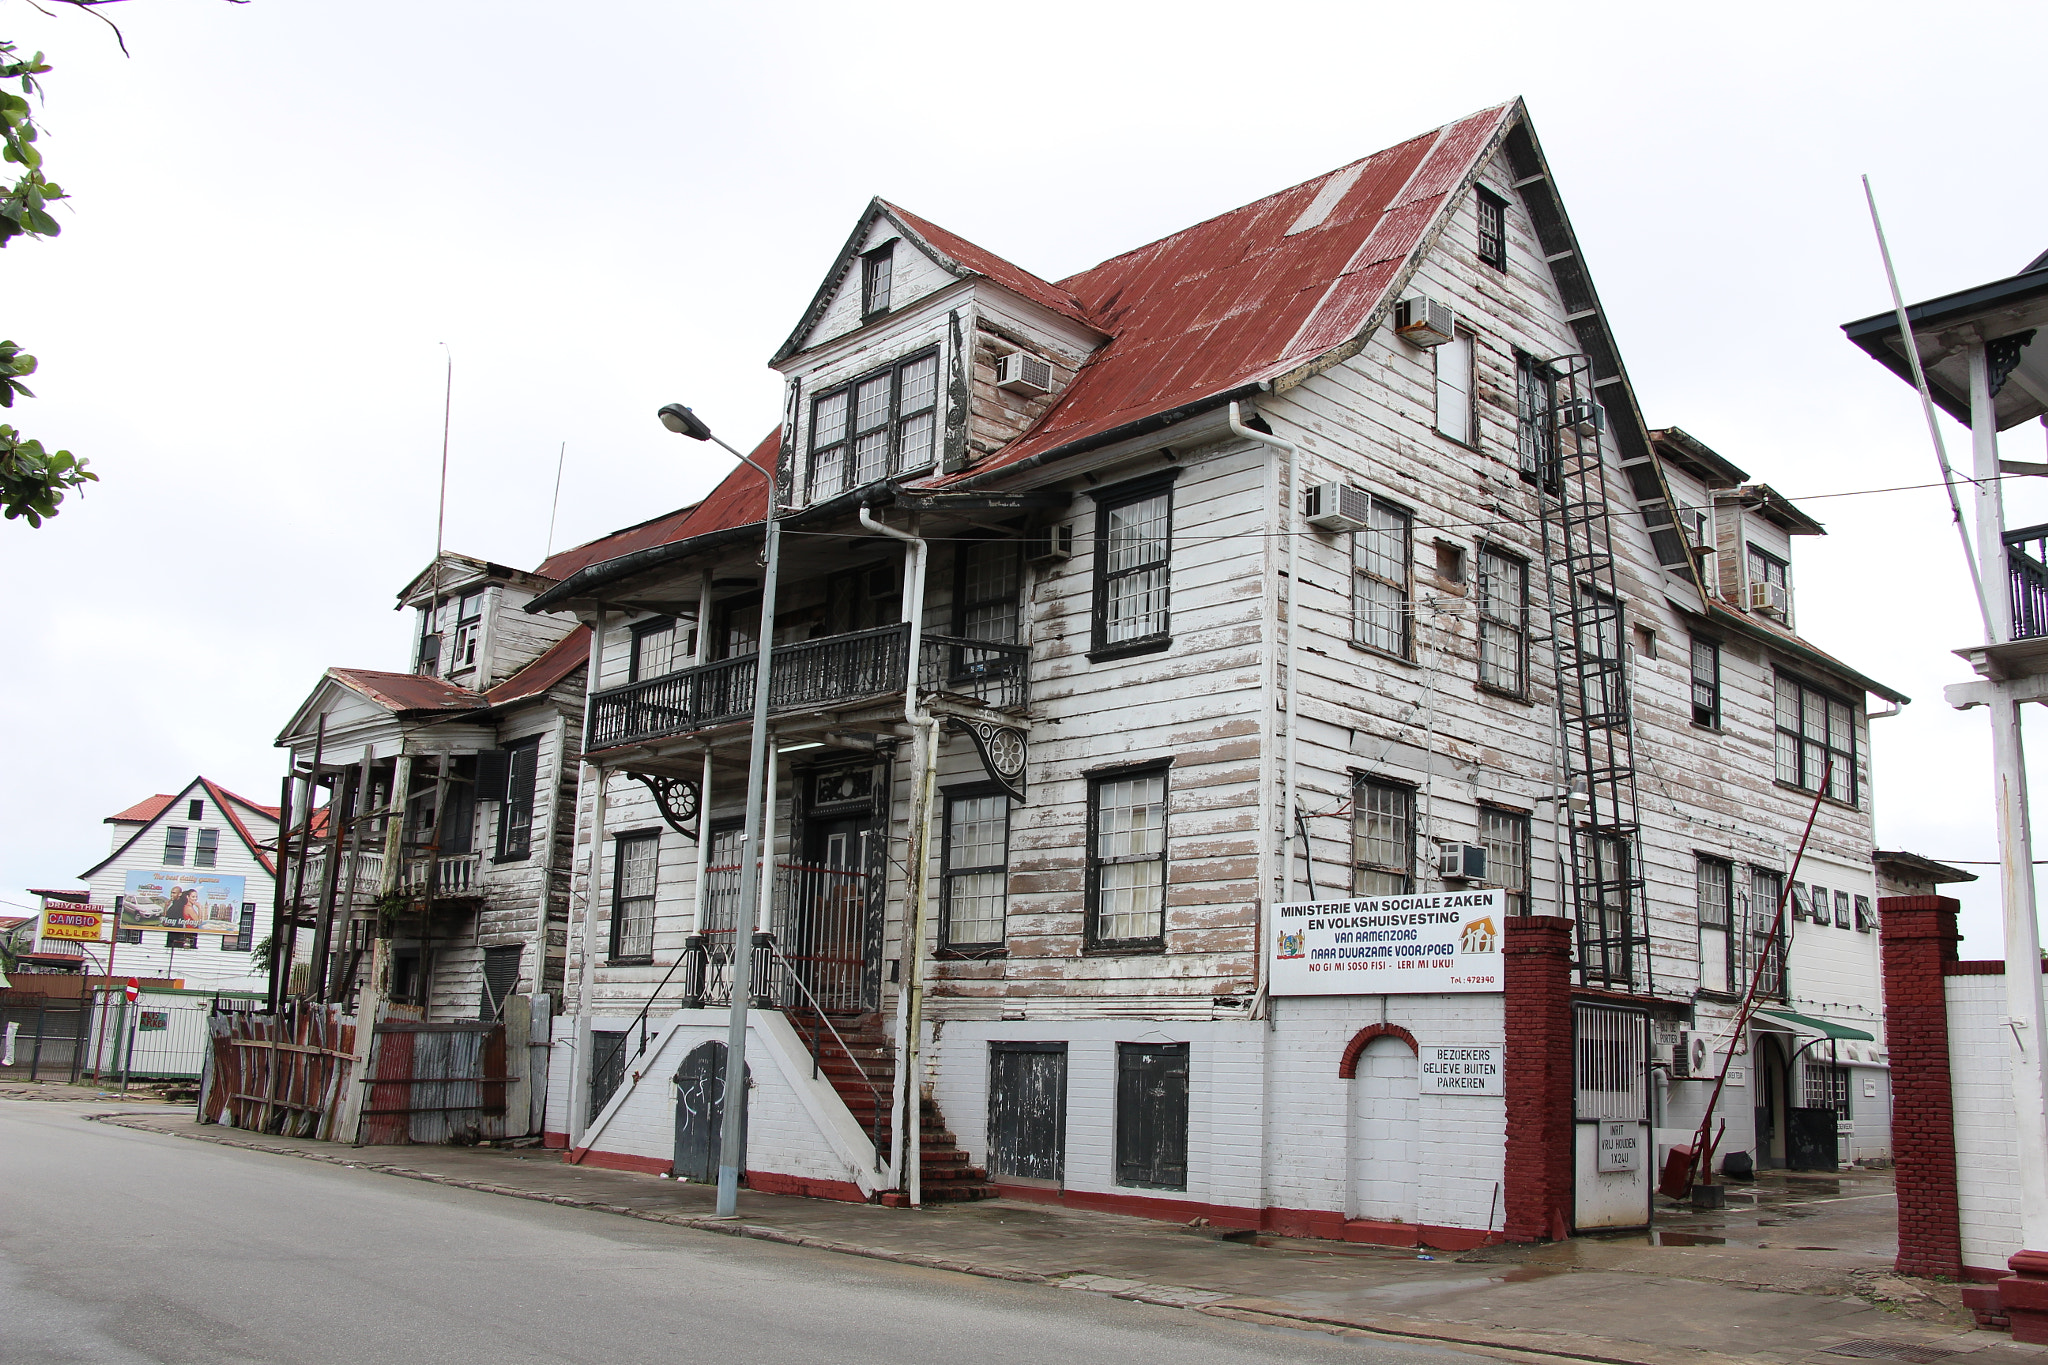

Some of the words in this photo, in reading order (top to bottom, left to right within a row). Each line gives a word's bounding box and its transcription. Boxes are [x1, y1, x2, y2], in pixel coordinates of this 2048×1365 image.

[179, 875, 197, 883] daily
[48, 902, 103, 911] DRIVE-THRU
[1281, 903, 1351, 917] MINISTERIE
[1354, 901, 1378, 912] VAN
[1382, 898, 1440, 911] SOCIALE
[1444, 894, 1492, 907] ZAKEN
[49, 914, 94, 926] CAMBIO
[160, 916, 177, 925] Play
[178, 918, 202, 927] today!
[1308, 919, 1324, 930] EN
[1328, 912, 1459, 929] VOLKSHUISVESTING
[47, 928, 99, 937] DALLEX
[1335, 932, 1353, 943] VAN
[1356, 929, 1417, 942] ARMENZORG
[1311, 948, 1336, 959] NAAR
[1339, 946, 1392, 958] DUURZAME
[1395, 944, 1454, 956] VOORSPOED
[1309, 963, 1320, 972] NO
[1323, 963, 1332, 971] GI
[1335, 962, 1345, 971] MI
[1348, 962, 1368, 970] SOSO
[1371, 961, 1386, 970] FISI
[1398, 960, 1414, 969] LERI
[1418, 960, 1429, 968] MI
[1432, 959, 1454, 968] UKU!
[1660, 1033, 1678, 1043] PORTIER
[1437, 1049, 1490, 1060] BEZOEKERS
[1423, 1063, 1460, 1074] GELIEVE
[1464, 1064, 1496, 1075] BUITEN
[1437, 1078, 1485, 1088] PARKEREN
[1602, 1139, 1613, 1150] VRIJ
[1616, 1138, 1636, 1149] HOUDEN
[1611, 1153, 1628, 1164] 1X24U
